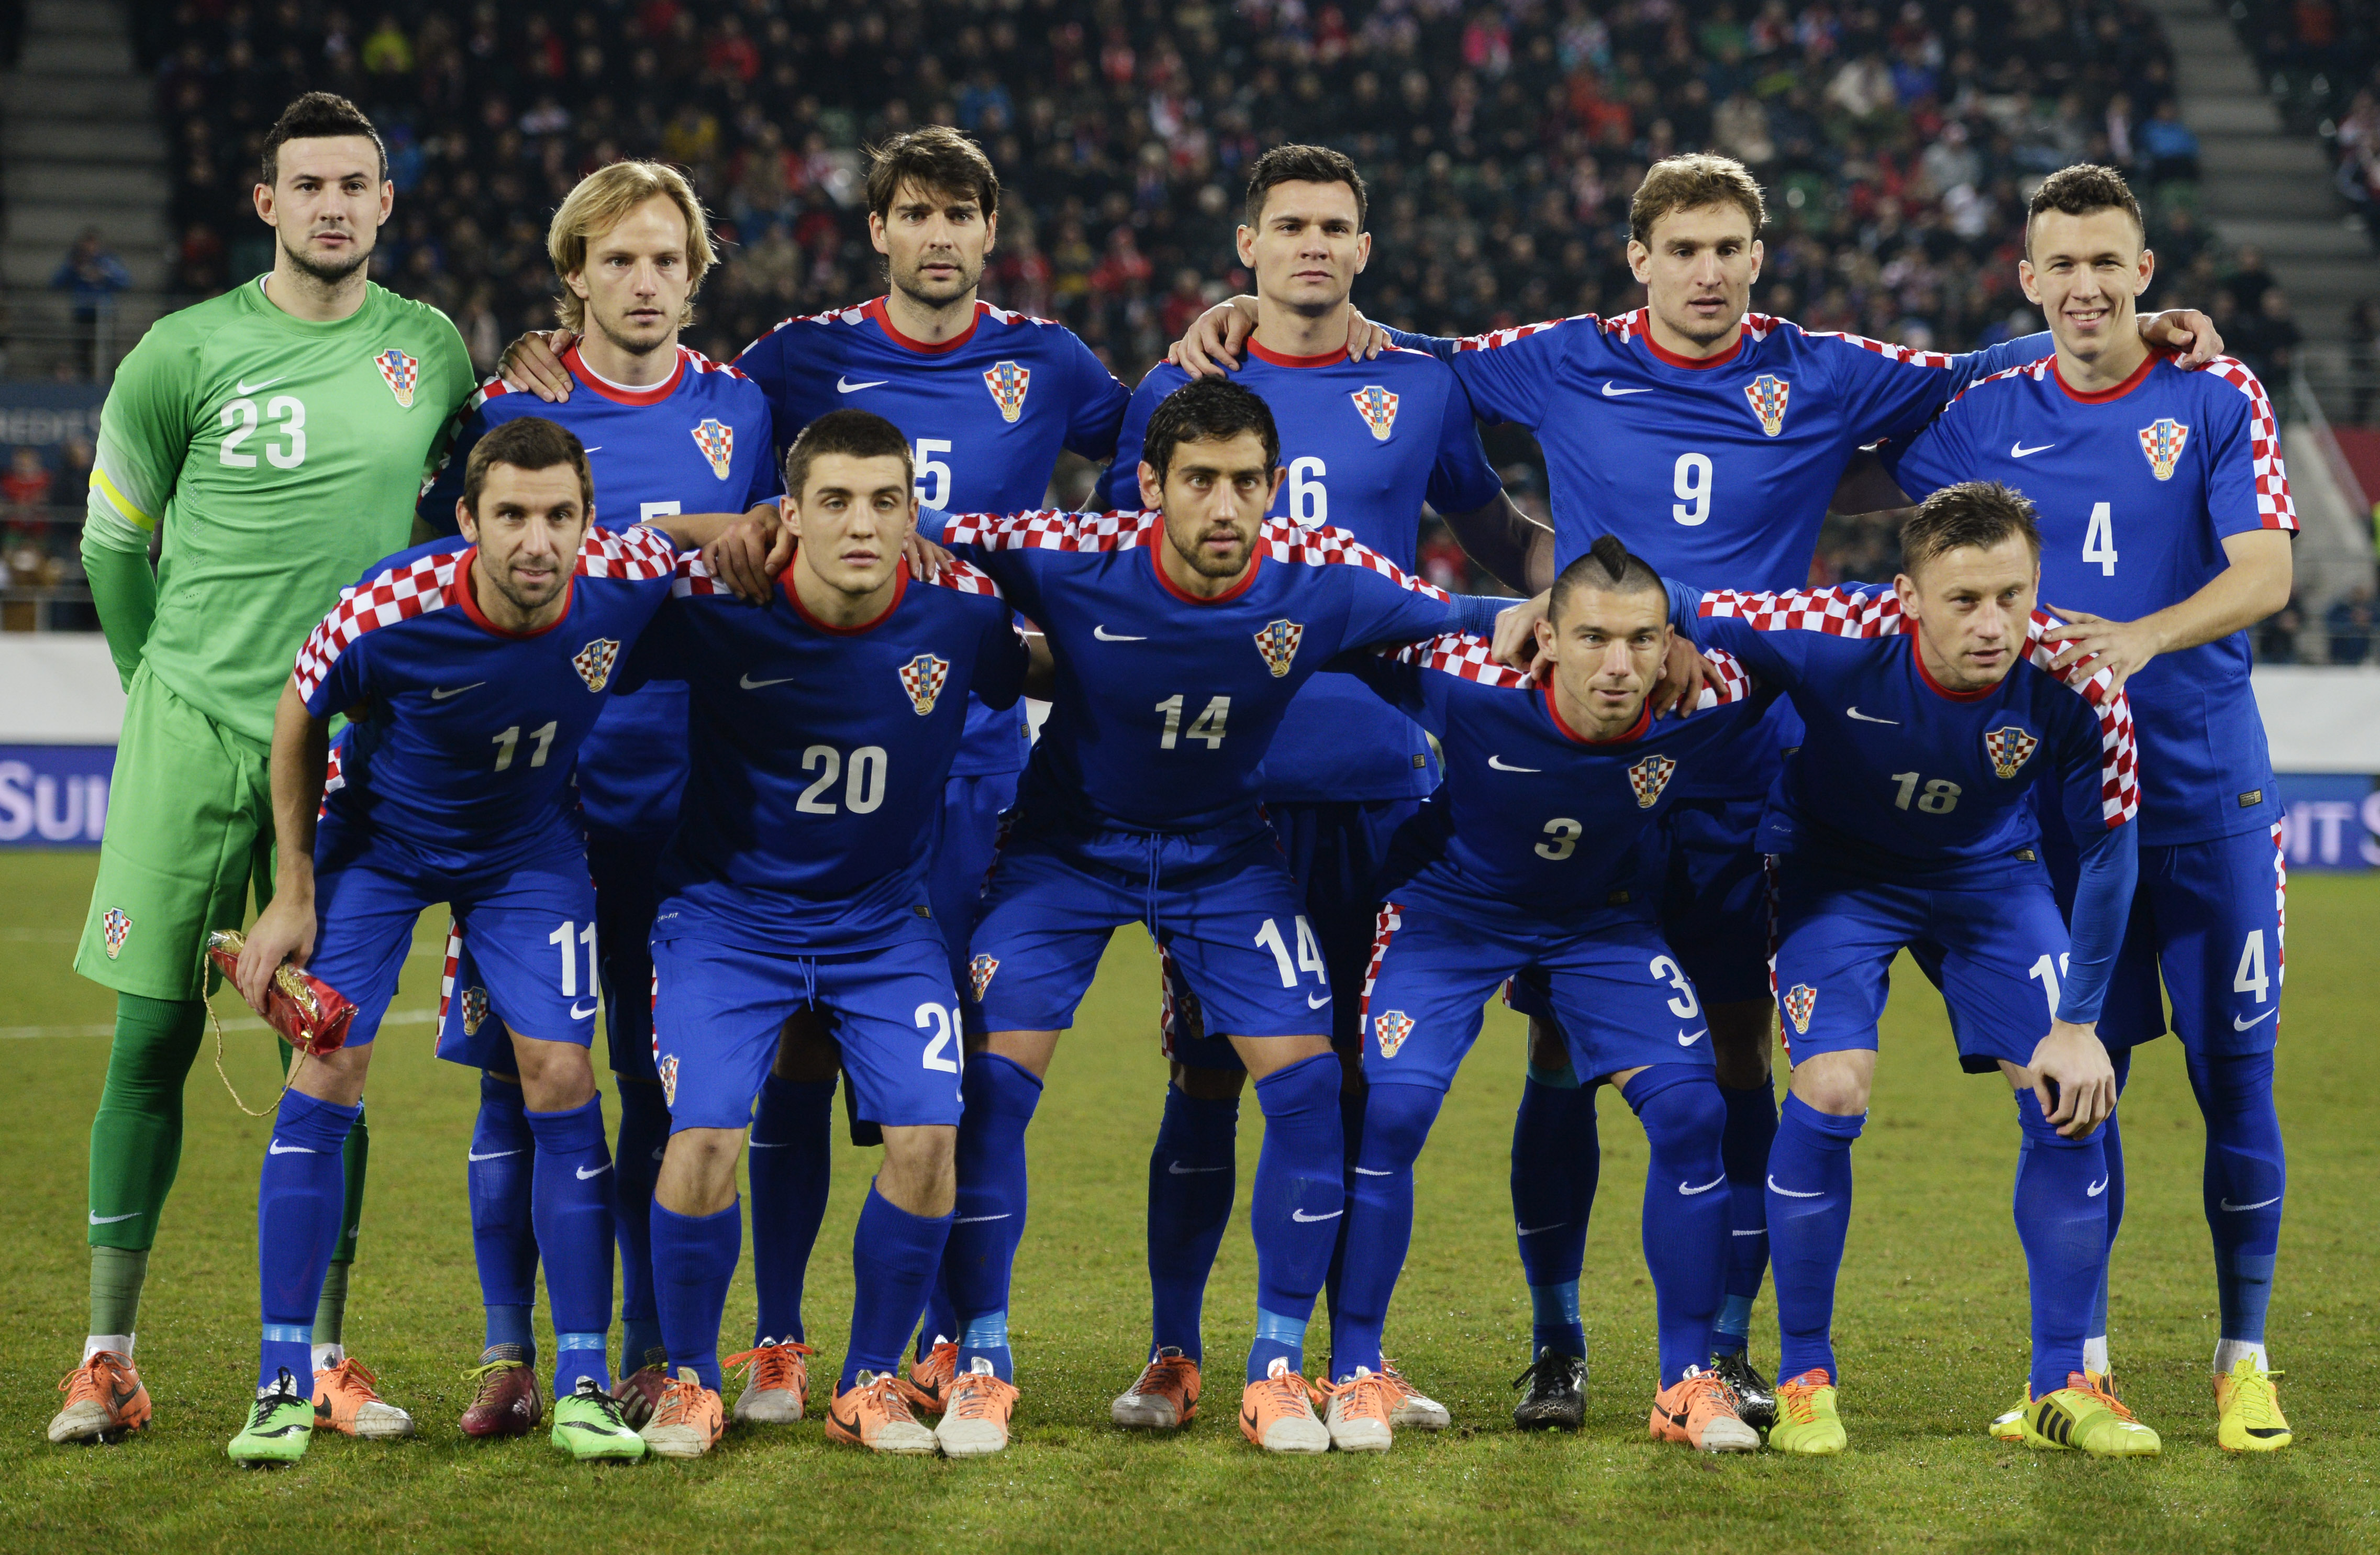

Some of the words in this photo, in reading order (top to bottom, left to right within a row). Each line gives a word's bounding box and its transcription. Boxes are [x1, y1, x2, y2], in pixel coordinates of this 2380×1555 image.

[219, 396, 306, 469] 23
[914, 438, 951, 511] 5
[1288, 456, 1328, 529] 6
[1673, 452, 1713, 526] 9
[2083, 502, 2118, 576] 4
[493, 721, 557, 771] 11
[1155, 695, 1231, 749] 14
[796, 745, 887, 814] 20
[1891, 771, 1962, 814] 18
[1534, 818, 1582, 860] 3
[549, 921, 597, 997] 11
[1254, 915, 1326, 988] 14
[1650, 955, 1698, 1019] 3
[2029, 952, 2070, 1024] 1
[2233, 929, 2269, 1003] 4
